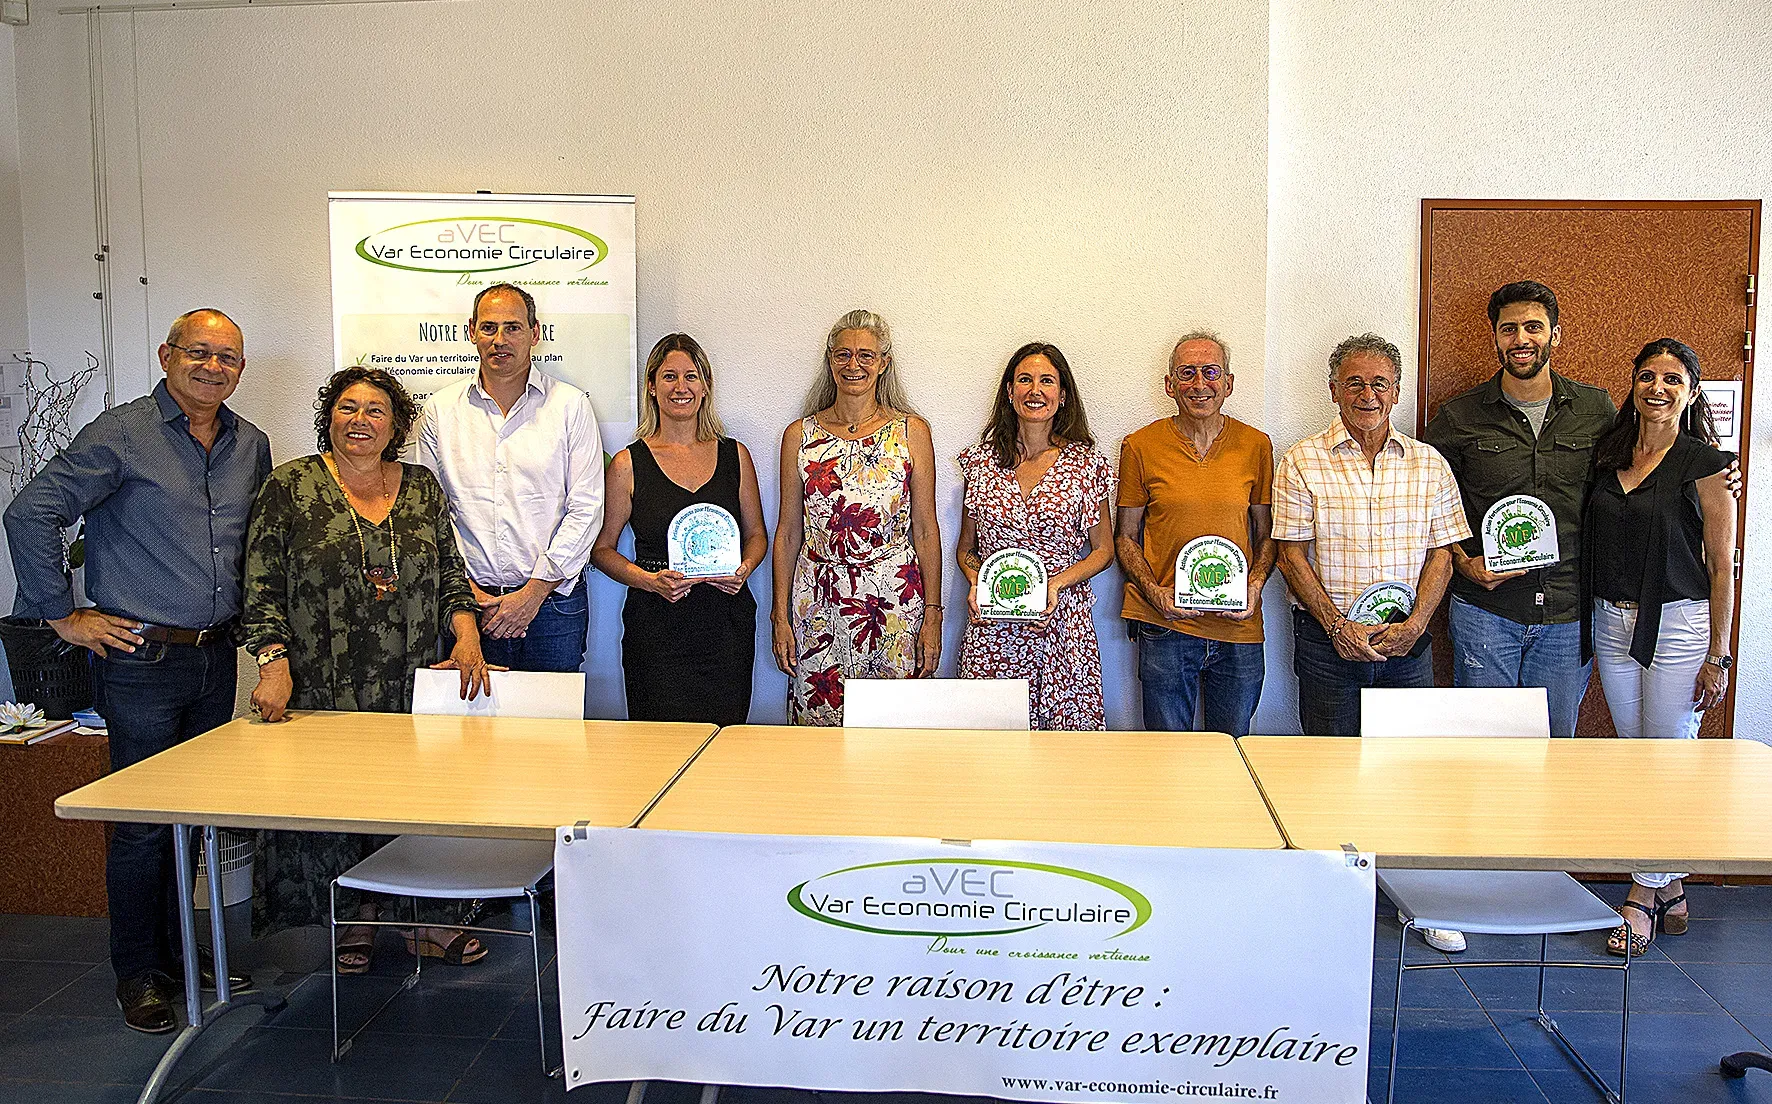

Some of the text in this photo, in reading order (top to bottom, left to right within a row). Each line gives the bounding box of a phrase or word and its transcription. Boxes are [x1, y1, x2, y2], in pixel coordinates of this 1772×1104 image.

[438, 224, 515, 243] aVEC
[371, 245, 595, 260] Var Economie Circulaire
[456, 271, 484, 287] Pour
[512, 278, 560, 286] croissance
[567, 276, 609, 286] vertueuse
[371, 354, 391, 363] Faire
[394, 354, 405, 363] du
[408, 355, 424, 363] Var
[426, 355, 438, 363] un
[440, 353, 480, 363] territoire
[544, 354, 563, 363] plan
[435, 366, 476, 375] circulaire
[412, 393, 428, 402] par
[902, 867, 1014, 898] aVEC
[810, 894, 1130, 923] Var Economie Circulaire
[926, 935, 1151, 962] Pour une croissance vertueuse
[752, 964, 1170, 1008] Notre raison d'être :
[572, 1000, 1359, 1067] Faire du Var un territoire exemplaire
[1001, 1076, 1279, 1100] www.var-economie-circulaire.fr
